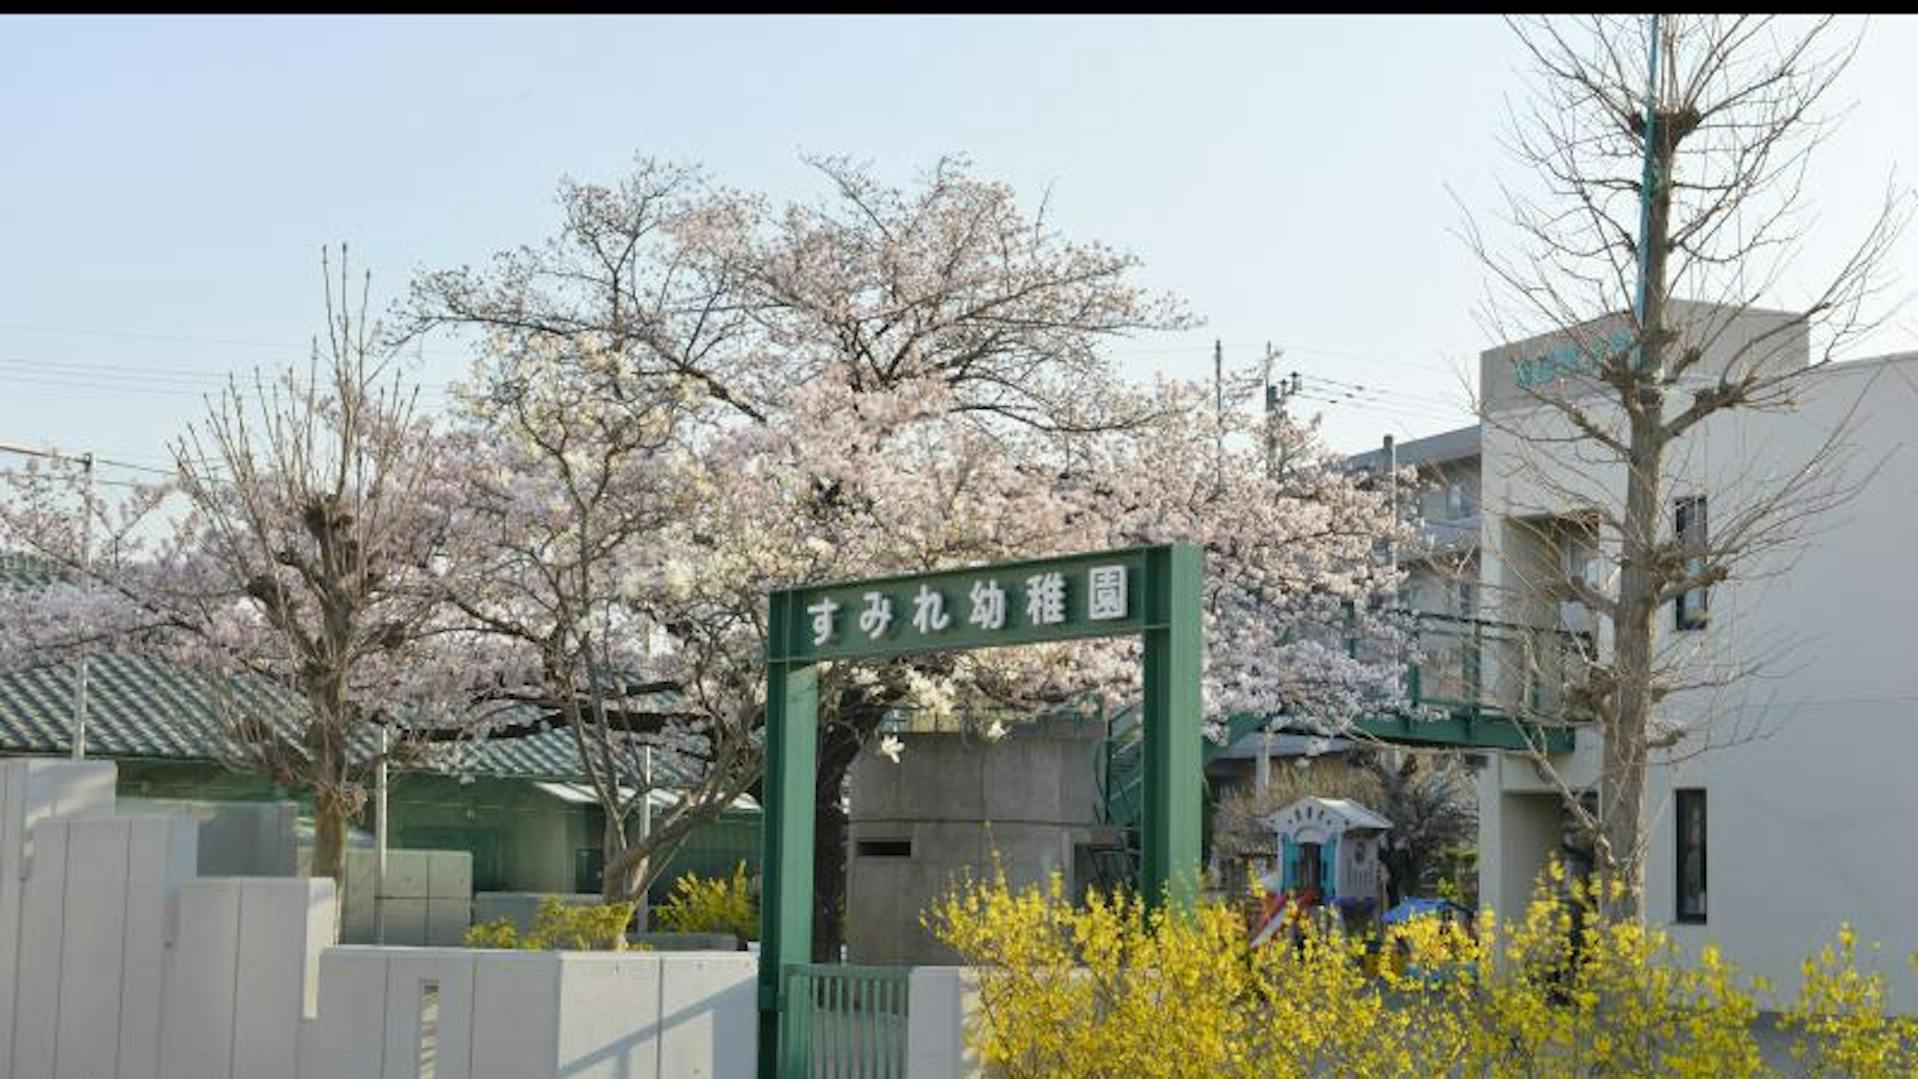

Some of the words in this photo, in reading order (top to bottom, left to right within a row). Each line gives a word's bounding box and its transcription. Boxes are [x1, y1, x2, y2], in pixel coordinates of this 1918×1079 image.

[807, 564, 1128, 646] すみれ幼稚園
